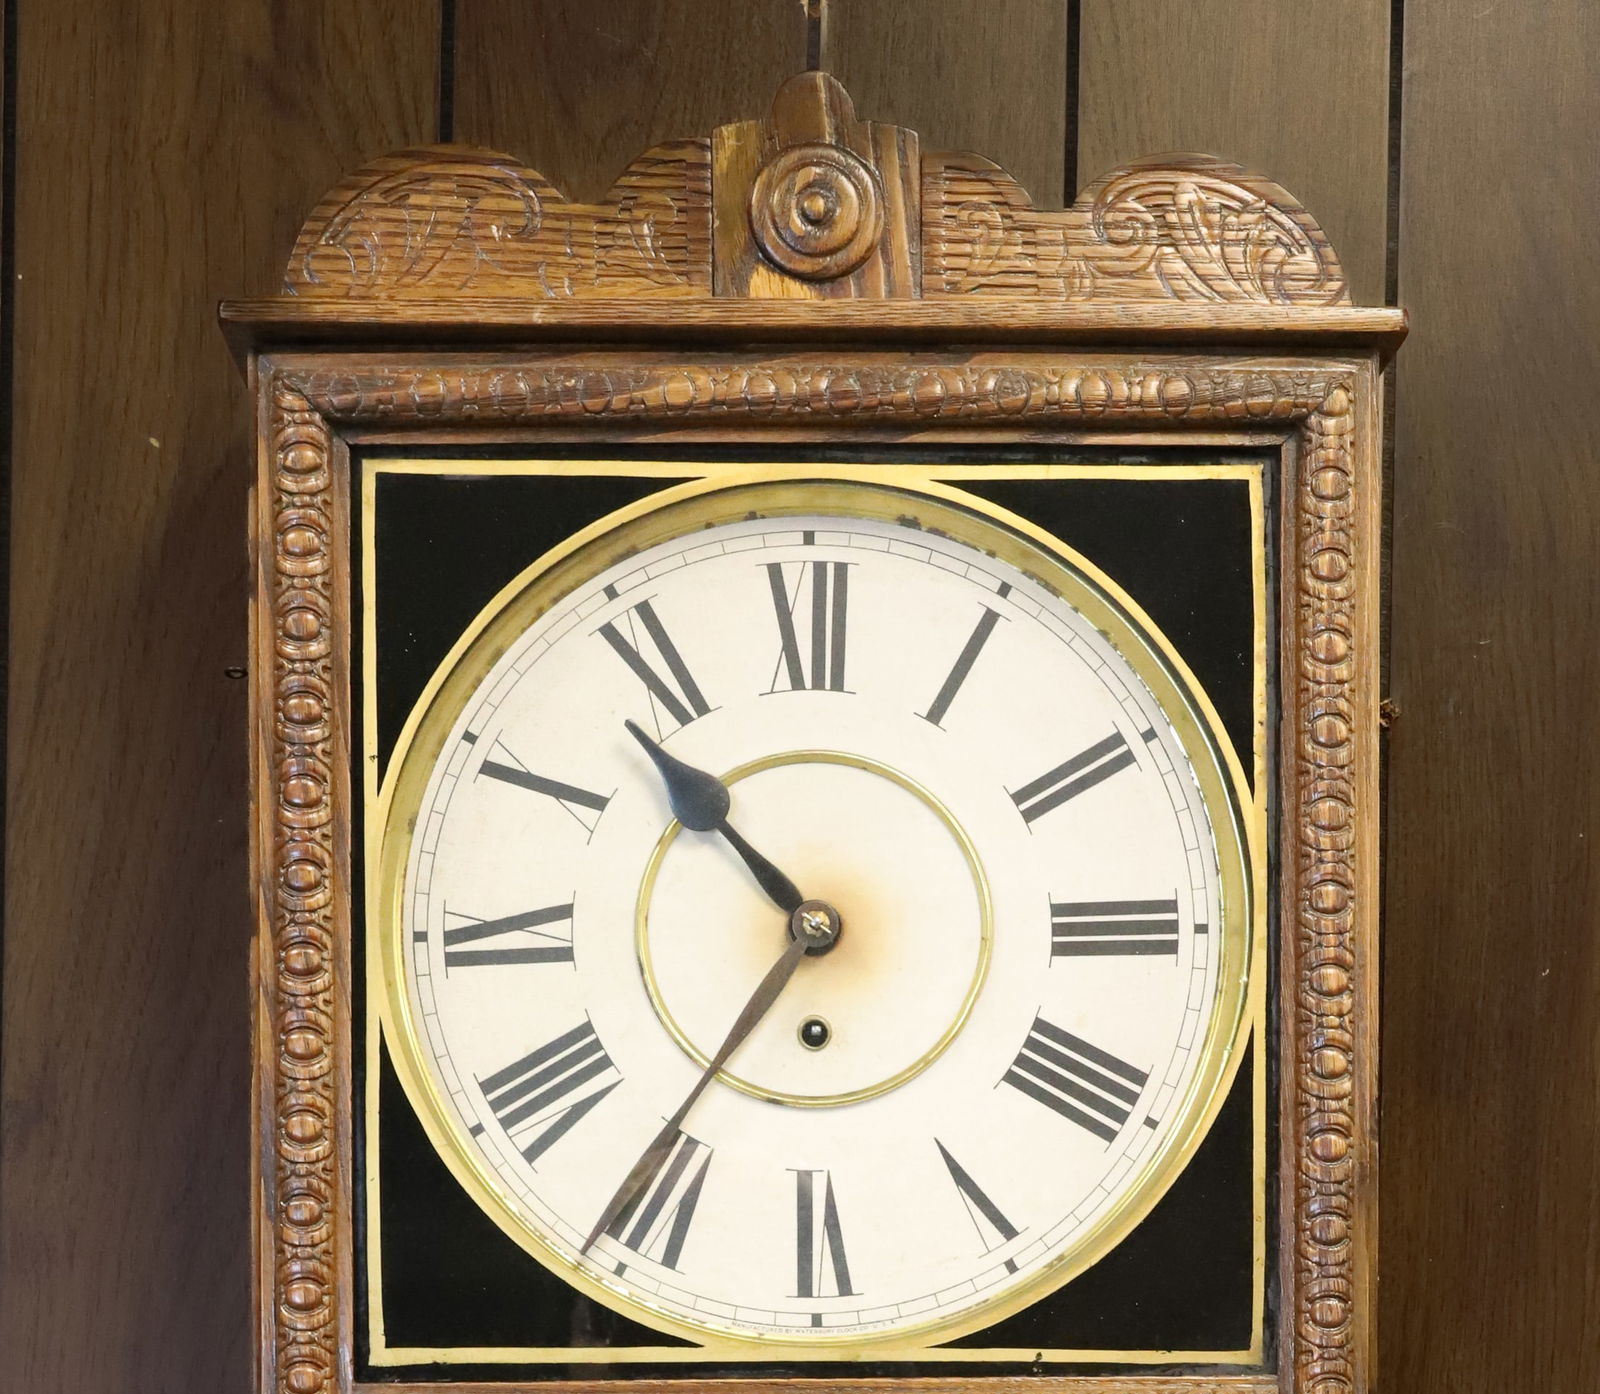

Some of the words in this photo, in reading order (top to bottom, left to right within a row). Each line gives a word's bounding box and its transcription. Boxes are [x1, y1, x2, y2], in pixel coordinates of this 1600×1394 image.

[588, 593, 723, 746] XI
[755, 561, 860, 697] XII
[913, 601, 1012, 732] I
[473, 728, 618, 846] X
[1003, 720, 1143, 835] II
[443, 889, 577, 980] IX
[1048, 887, 1179, 968] III
[472, 1007, 625, 1174] VIII
[993, 1004, 1154, 1154] IIII
[785, 1167, 864, 1299] VI
[933, 1136, 1029, 1259] V
